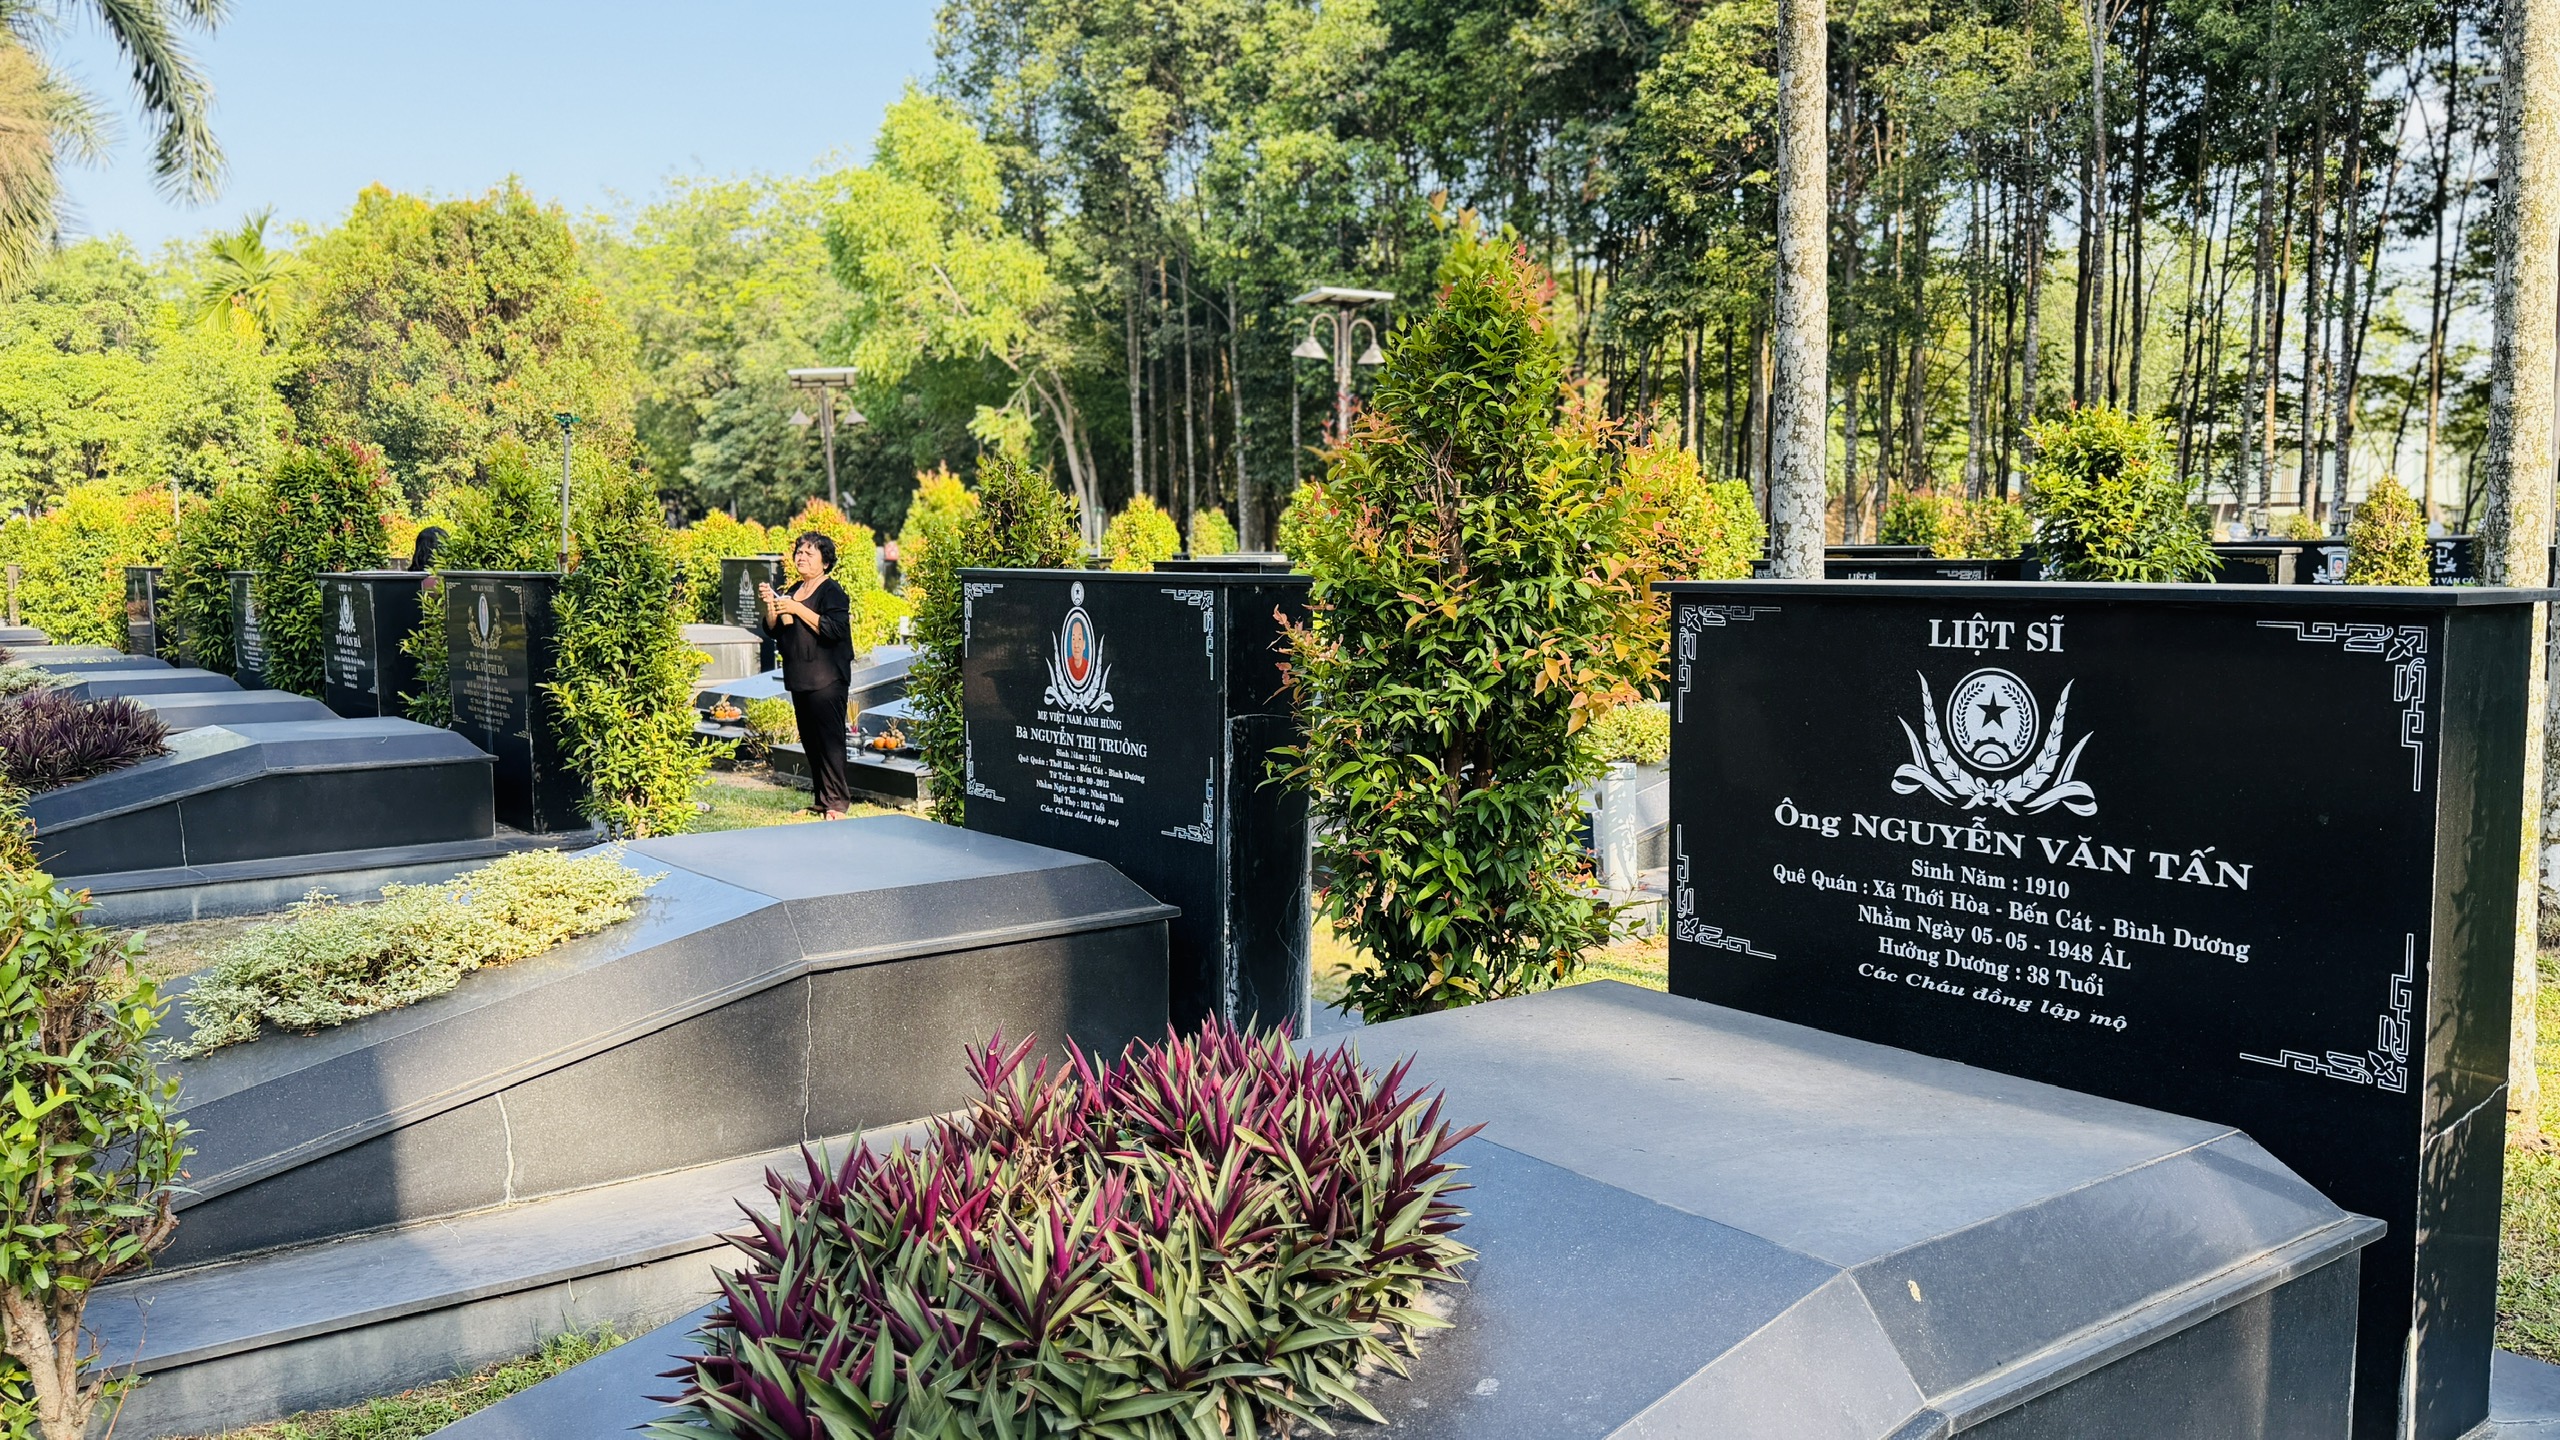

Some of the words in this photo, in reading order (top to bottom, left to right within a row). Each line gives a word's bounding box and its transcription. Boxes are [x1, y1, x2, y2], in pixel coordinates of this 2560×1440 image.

[1928, 612, 2014, 656] LIỆT
[2027, 615, 2064, 652] SĨ
[1016, 726, 1028, 739] Bà
[1031, 726, 1074, 746] NGUYỄN
[1077, 734, 1096, 752] THỊ
[1037, 710, 1048, 722] MẸ
[1049, 711, 1065, 724] VIỆT
[1067, 714, 1082, 725] NAM
[1084, 717, 1099, 727] ANH
[1100, 718, 1122, 730] HÙNG
[1056, 749, 1069, 758] Sinh
[1775, 797, 1841, 837] Ông
[1852, 813, 2025, 858] NGUYỄN
[2037, 835, 2135, 874] VĂN
[2149, 846, 2253, 890] TẤN
[1912, 859, 1954, 881] Sinh
[1961, 866, 2006, 889] Năm
[2026, 877, 2069, 899] 1910
[1773, 864, 1805, 884] Quê
[1812, 870, 1857, 892] Quán
[1873, 880, 1896, 899] Xã
[1902, 884, 1944, 907] Thới
[1951, 892, 1989, 915] Hòa
[2009, 901, 2048, 925] Bến
[2056, 909, 2092, 932] Cát
[2113, 918, 2166, 944] Bình
[2173, 928, 2250, 963] Dương
[1858, 905, 1911, 930] Nhằm
[1917, 915, 1965, 943] Ngày
[2048, 939, 2092, 962] 1948
[2099, 942, 2131, 969] ÂL
[1878, 936, 1940, 967] Hưởng
[1945, 949, 2009, 982] Dương
[2027, 965, 2049, 985] 38
[2056, 970, 2104, 996] Tuổi
[1859, 963, 1898, 982] Các
[1906, 974, 1964, 996] Cháu
[1973, 988, 2032, 1012] đồng
[2041, 1000, 2080, 1021] lập
[2090, 1014, 2127, 1032] mộ
